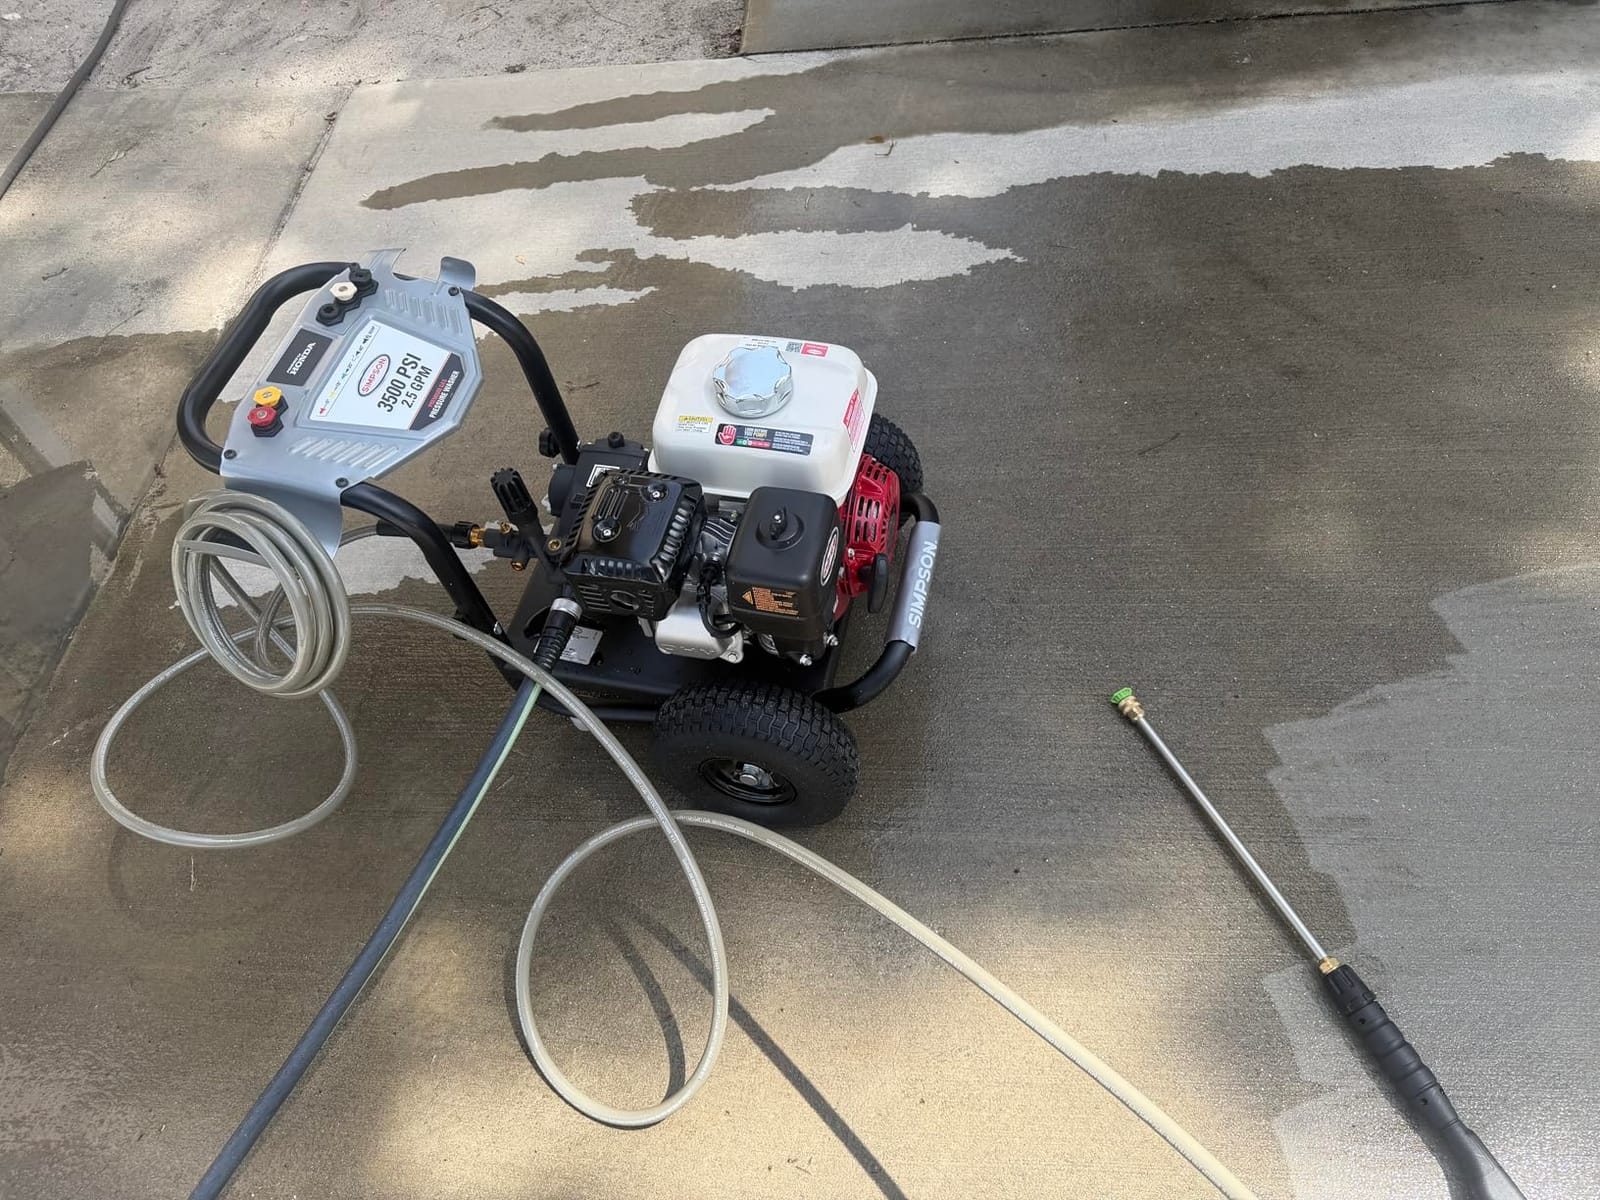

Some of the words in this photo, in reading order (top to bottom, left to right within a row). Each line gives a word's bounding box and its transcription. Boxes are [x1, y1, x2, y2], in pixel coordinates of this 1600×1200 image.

[290, 342, 316, 375] HONDA
[361, 357, 387, 393] SIMPSON
[377, 377, 407, 413] 3500
[396, 352, 421, 379] PSI
[401, 391, 418, 408] 2.5
[410, 367, 433, 391] GPM
[429, 391, 448, 418] PRESSURE
[443, 370, 460, 392] WASHER
[909, 541, 938, 628] SIMPSON
